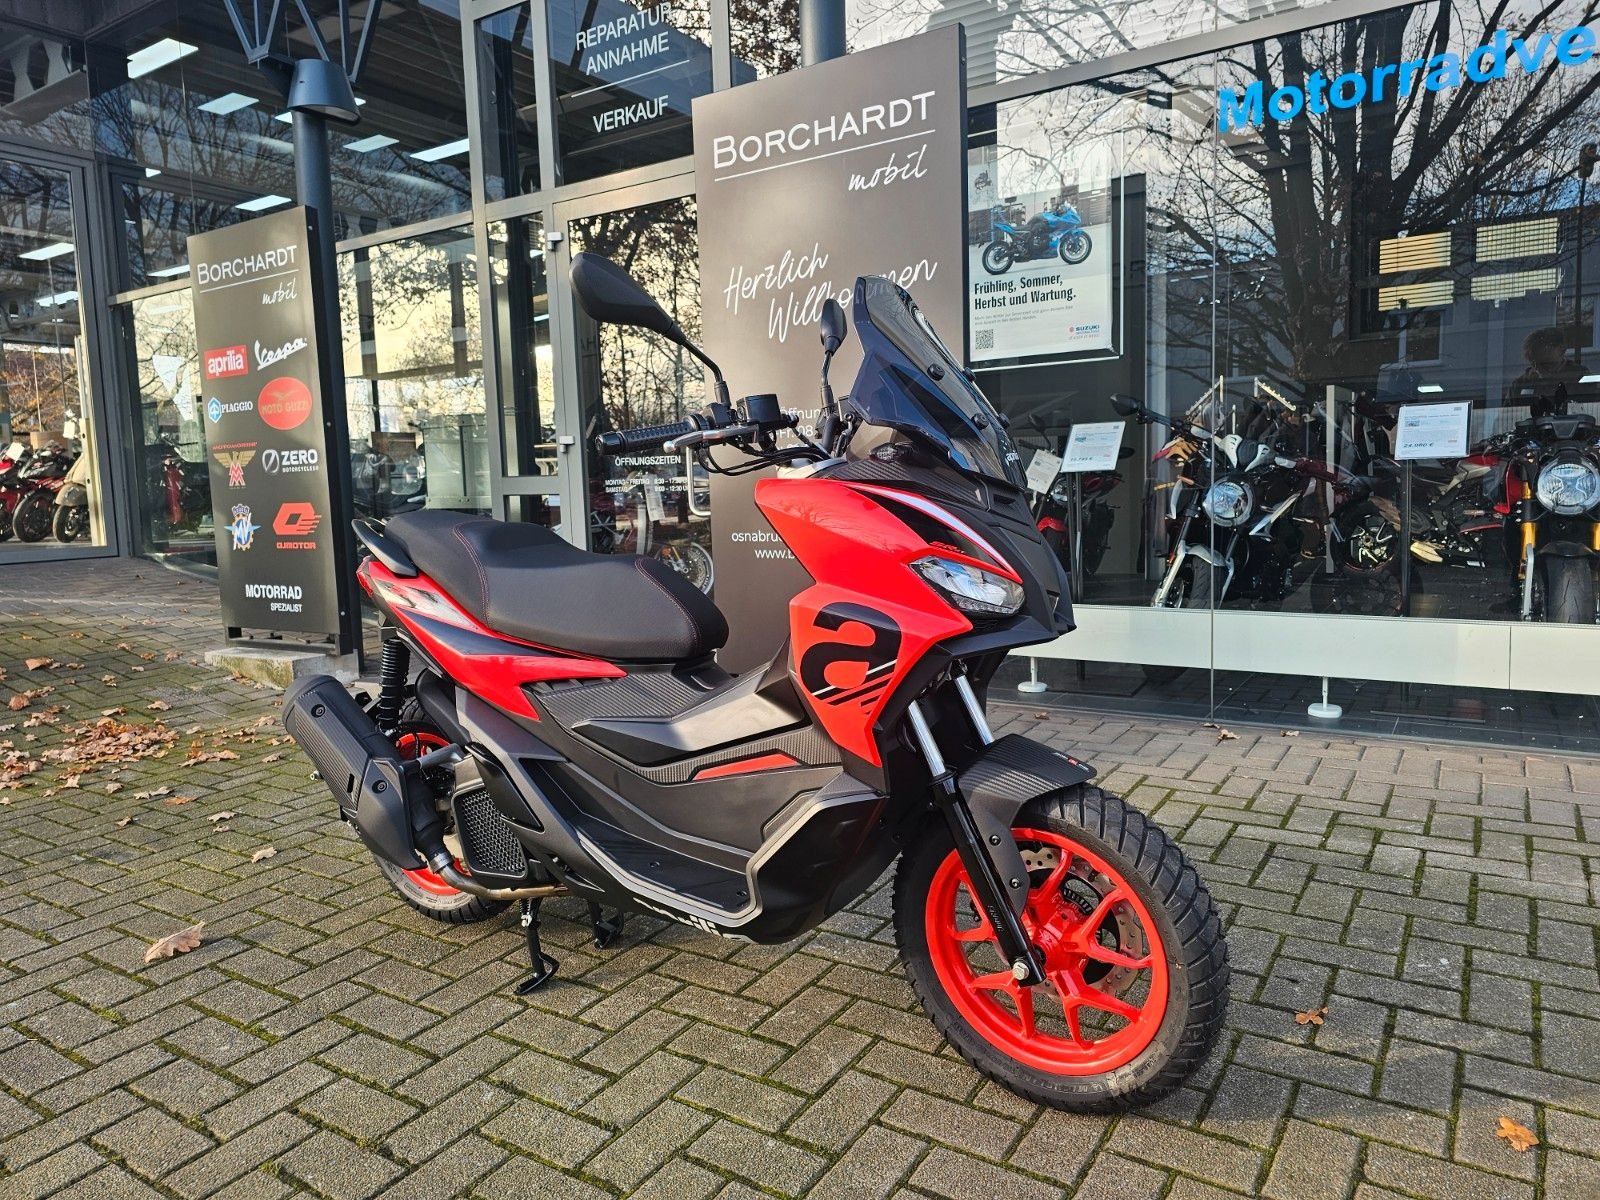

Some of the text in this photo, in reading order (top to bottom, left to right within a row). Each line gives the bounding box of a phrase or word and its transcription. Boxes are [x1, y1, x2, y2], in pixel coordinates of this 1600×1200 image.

[576, 2, 672, 51] REPARATUR
[586, 31, 669, 75] ANNAHME
[1218, 26, 1598, 133] Motorradve
[592, 95, 669, 133] VERKAUF
[713, 91, 936, 169] BORCHARDT
[848, 143, 928, 191] mobil
[197, 245, 297, 284] BORCHARDT
[723, 243, 829, 315] Herzlich
[262, 277, 298, 305] mobil
[974, 275, 1063, 295] Frühling, Sommer,
[974, 288, 1076, 310] Herbst und Wartung.
[768, 259, 938, 343] Willkoen
[207, 351, 244, 376] aprilia
[254, 337, 307, 371] Vespa
[221, 401, 254, 413] PIAGGIO
[262, 403, 282, 415] MOTO
[281, 448, 318, 466] ZERO
[614, 455, 682, 467] ÖFFNUNGSZEITEN
[245, 584, 302, 600] MOTORRAD
[270, 602, 302, 613] SPEZIALIST
